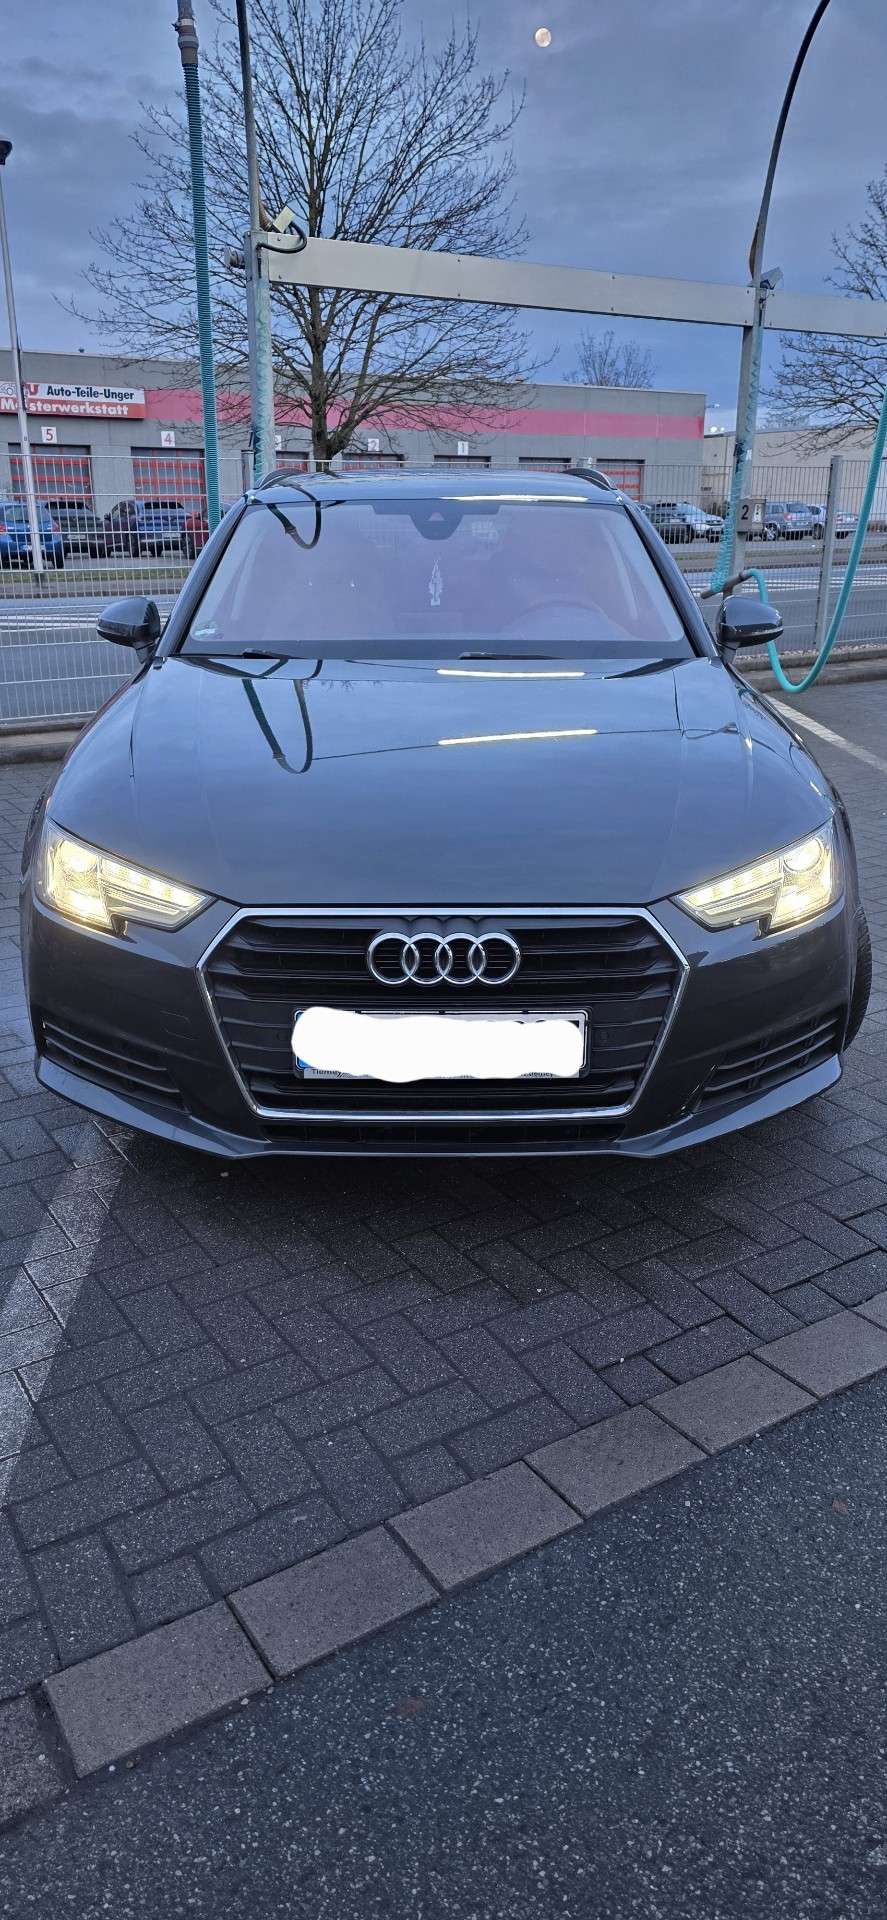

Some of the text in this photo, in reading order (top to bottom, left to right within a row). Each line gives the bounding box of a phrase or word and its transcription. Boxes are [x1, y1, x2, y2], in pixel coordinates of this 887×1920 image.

[46, 385, 135, 401] Auto-Teile-Unger
[0, 398, 129, 416] Msterwerkstatt
[45, 429, 54, 441] 5
[163, 432, 173, 444] 4
[369, 439, 377, 451] 2
[741, 504, 750, 520] 2
